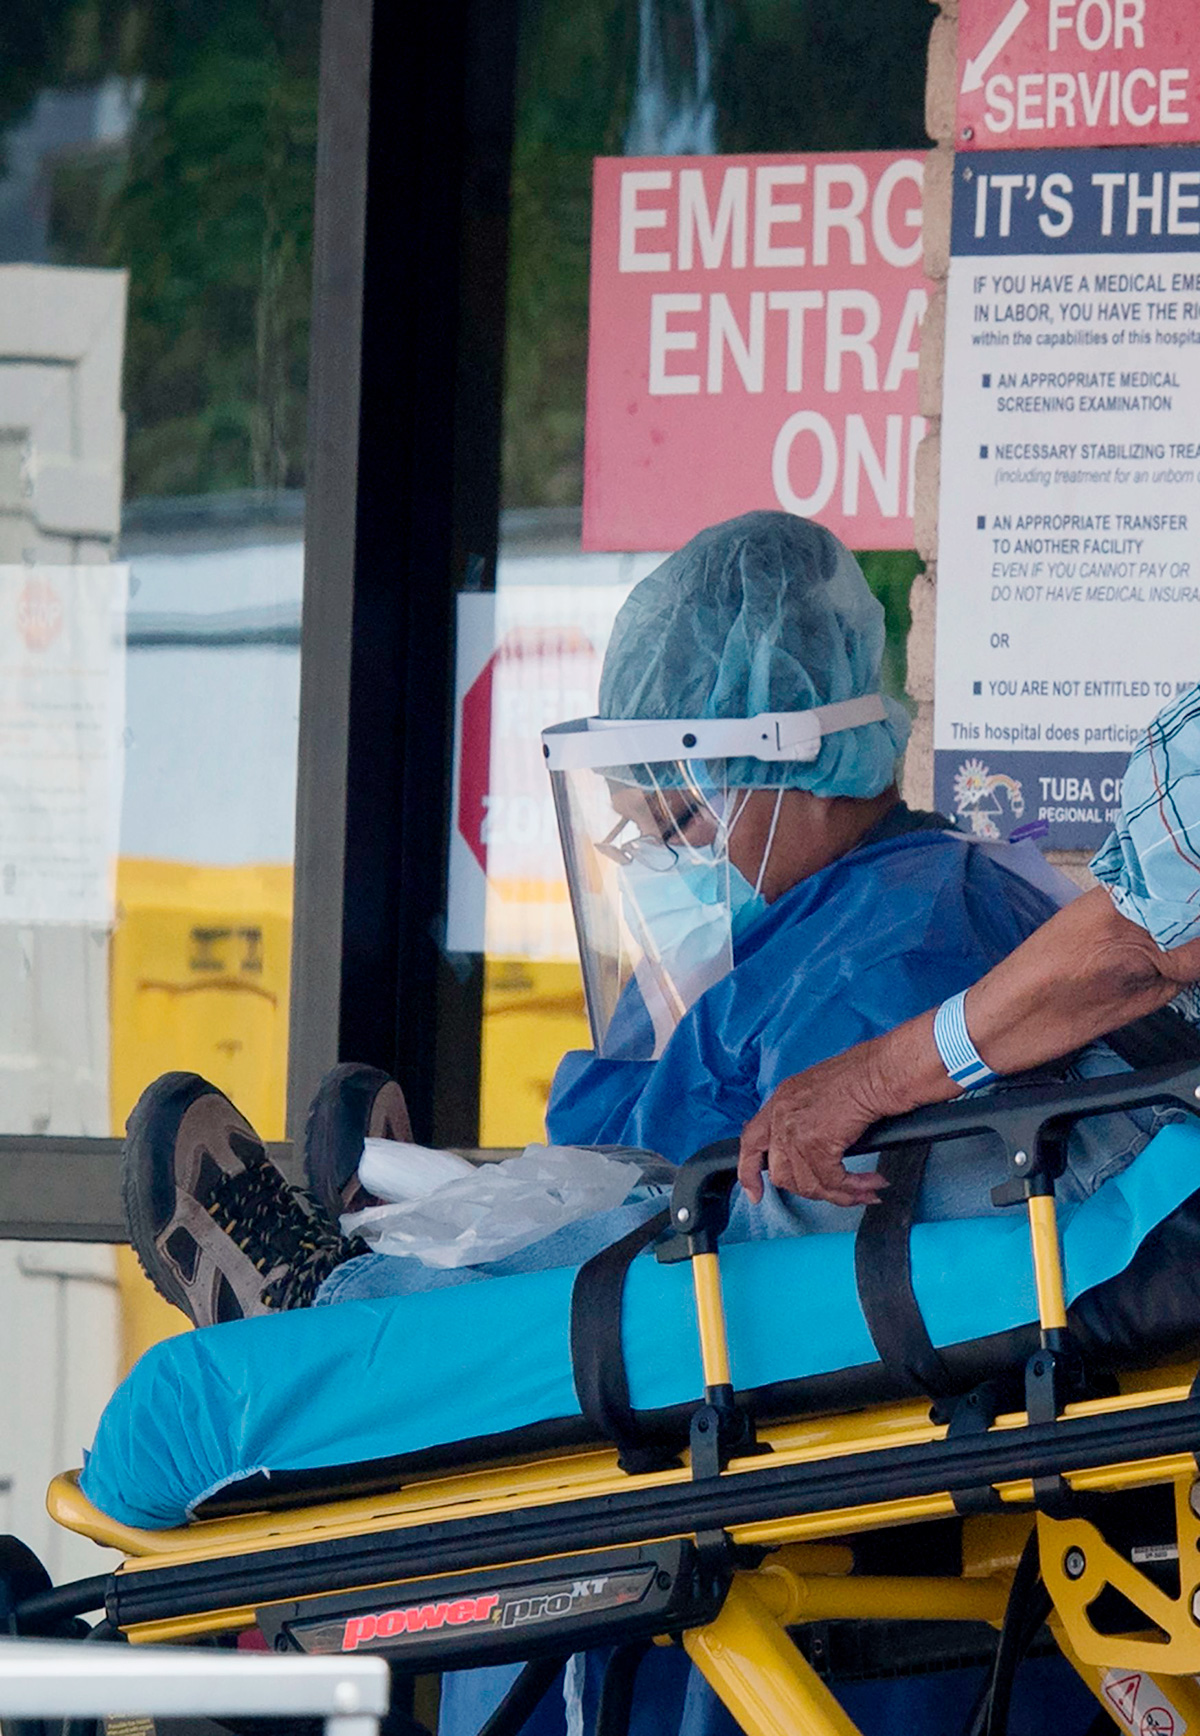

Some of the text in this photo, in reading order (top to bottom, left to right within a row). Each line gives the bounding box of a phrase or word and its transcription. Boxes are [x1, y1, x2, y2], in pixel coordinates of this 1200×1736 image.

[1049, 0, 1144, 51] FOR
[984, 68, 1189, 133] SERVICE
[974, 173, 1073, 238] IT'S
[619, 159, 925, 272] EMERG
[974, 276, 986, 293] IF
[992, 276, 1025, 293] YOU
[1031, 276, 1072, 293] HAVE
[1078, 275, 1091, 292] A
[1095, 275, 1166, 292] MEDICAL
[974, 304, 989, 321] IN
[995, 304, 1054, 325] LABOR,
[1059, 303, 1092, 320] YOU
[1098, 303, 1141, 320] HAVE
[1146, 303, 1177, 320] THE
[972, 330, 1009, 345] within
[1013, 330, 1032, 345] the
[1036, 330, 1108, 349] capabilities
[1111, 330, 1125, 345] of
[1128, 329, 1151, 344] this
[998, 372, 1180, 388] AN APPROPRIATE MEDICAL
[997, 396, 1173, 412] SCREENING EXAMINATION
[995, 444, 1076, 459] NECESSARY
[1081, 444, 1165, 459] STABILIZING
[995, 467, 1051, 485] (including
[1054, 467, 1111, 481] treatment
[1114, 468, 1130, 482] for
[1133, 468, 1148, 482] an
[1152, 468, 1194, 482] unborn
[993, 515, 1188, 530] AN APPROPRIATE TRANSFER
[993, 539, 1143, 554] TO ANOTHER FACILITY
[992, 562, 1190, 578] EVEN IF YOU CANNOT PAY OR
[991, 586, 1011, 602] DO
[1014, 586, 1042, 602] NOT
[1046, 586, 1081, 602] HAVE
[1085, 586, 1145, 602] MEDICAL
[990, 633, 1010, 649] OR
[989, 681, 1016, 697] YOU
[1021, 681, 1049, 697] ARE
[1053, 681, 1081, 697] NOT
[1085, 681, 1150, 697] ENTITLED
[1154, 681, 1172, 697] TO
[952, 724, 980, 739] This
[985, 724, 1041, 743] hospital
[1045, 725, 1079, 740] does
[1039, 777, 1095, 801] TUBA
[1038, 806, 1102, 823] REGIONAL
[342, 1594, 499, 1652] power
